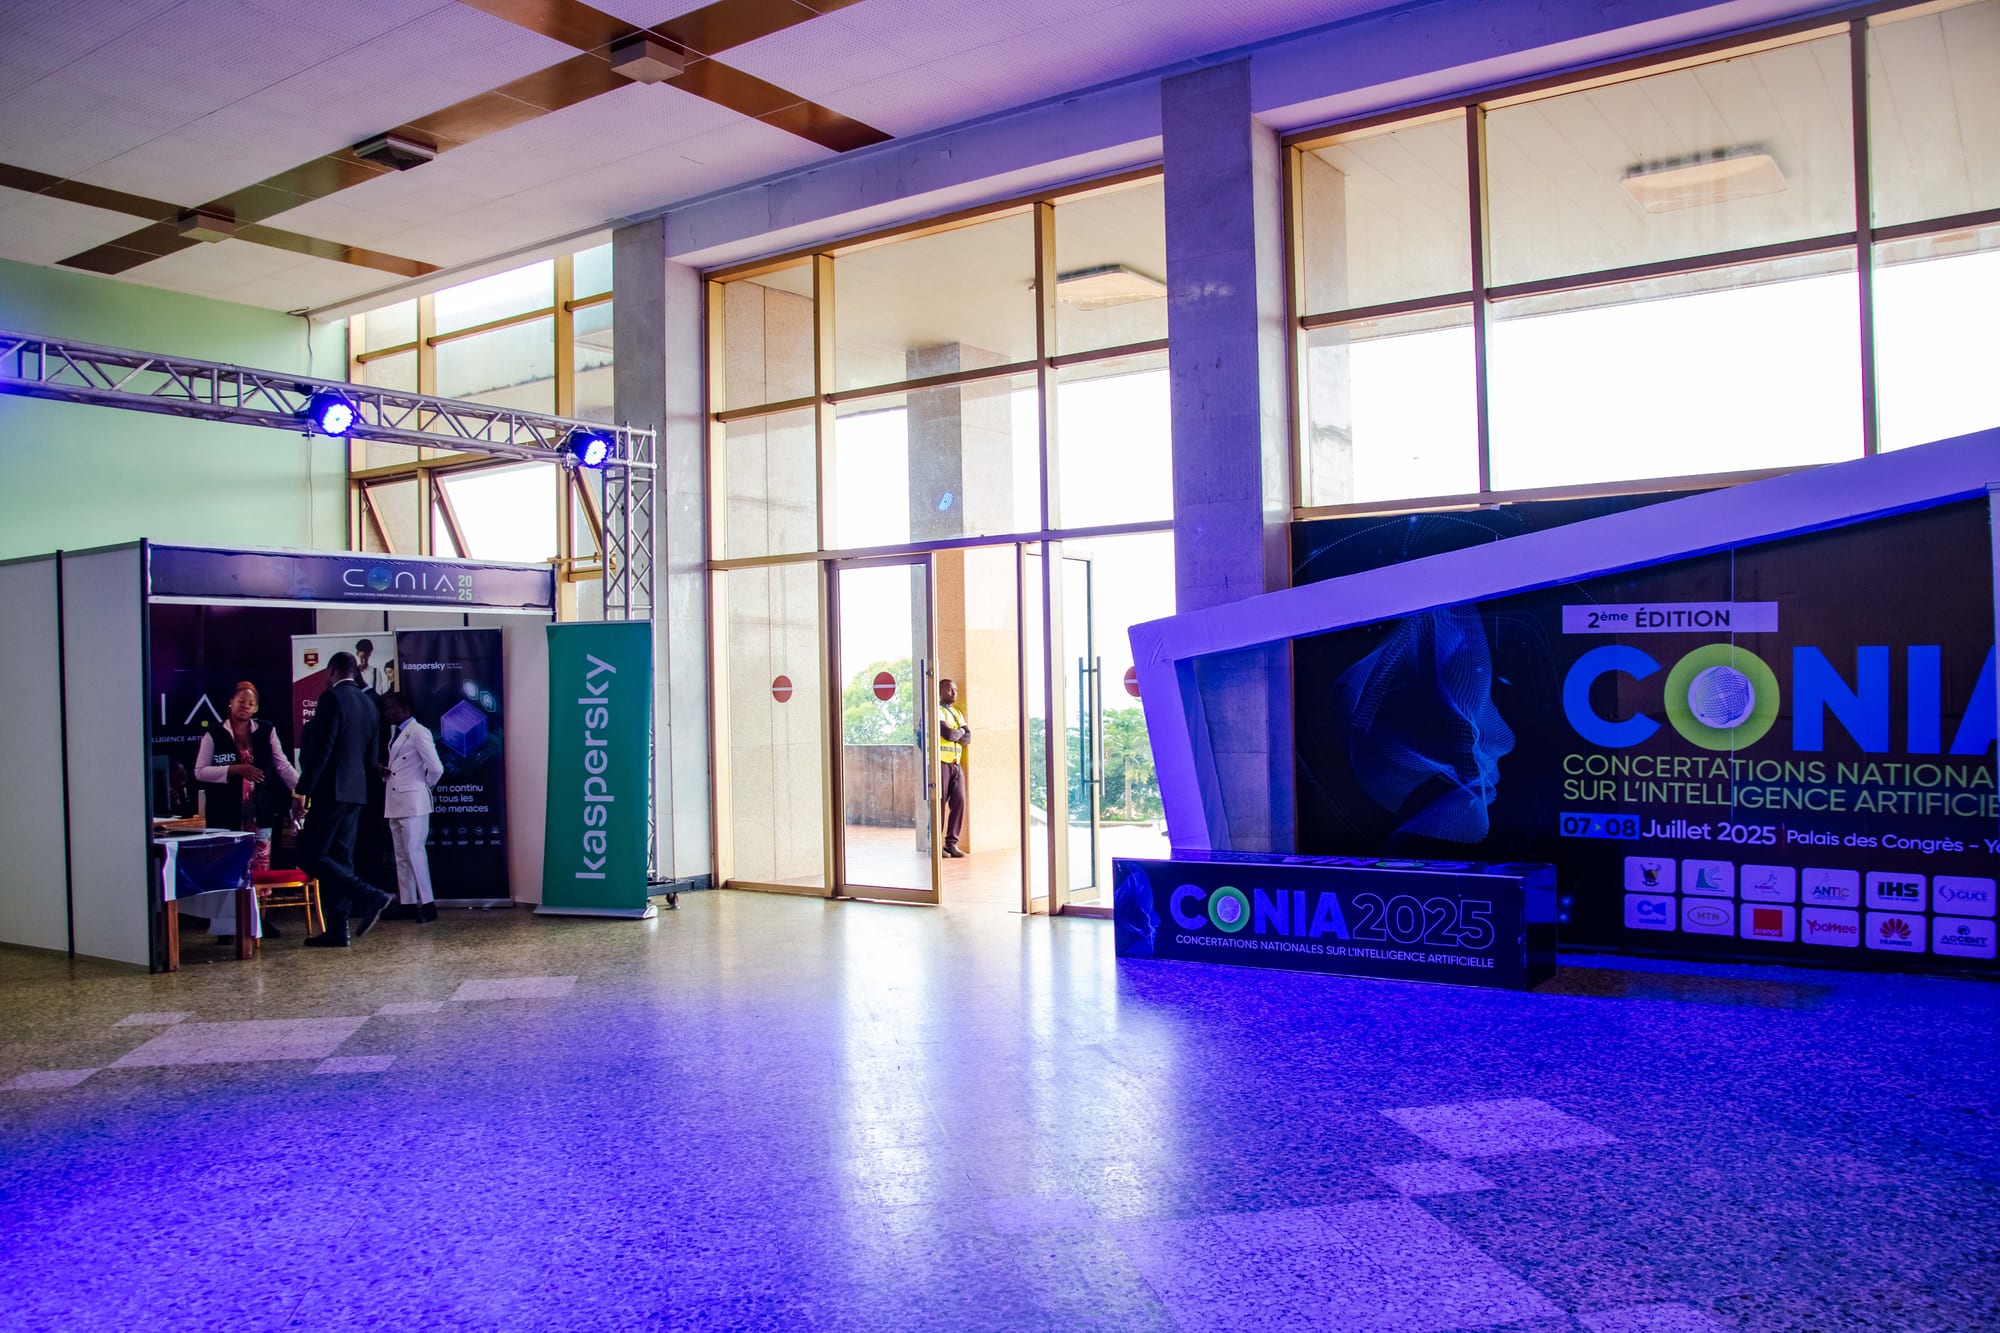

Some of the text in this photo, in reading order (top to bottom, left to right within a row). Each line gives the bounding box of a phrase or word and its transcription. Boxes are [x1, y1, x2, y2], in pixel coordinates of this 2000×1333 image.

[458, 575, 472, 587] 20
[458, 588, 472, 601] 25
[1635, 607, 1730, 628] ÉDITION
[402, 662, 445, 671] kaspersky
[575, 654, 617, 880] kaspersky
[1563, 754, 1826, 784] CONCERTATIONS
[449, 784, 484, 792] continu
[1563, 779, 1616, 801] SUR
[1624, 781, 1847, 812] L'INTELLIGENCE
[460, 794, 474, 802] les
[435, 804, 447, 812] de
[1642, 819, 1711, 840] Juillet
[1717, 822, 1776, 845] 2025
[1787, 830, 1840, 846] Palais
[1844, 833, 1877, 848] des
[1881, 834, 1964, 854] Congrès
[1812, 886, 1850, 897] ANTIC
[1878, 882, 1919, 897] IHS
[1170, 884, 1494, 950] CONIA 2025
[1697, 912, 1720, 921] MTN
[1806, 919, 1857, 935] Yoomee
[1176, 934, 1494, 968] CONCERTATIONS NATIONALES SUR L'INTELLIGENCE ARTIFICIELLE
